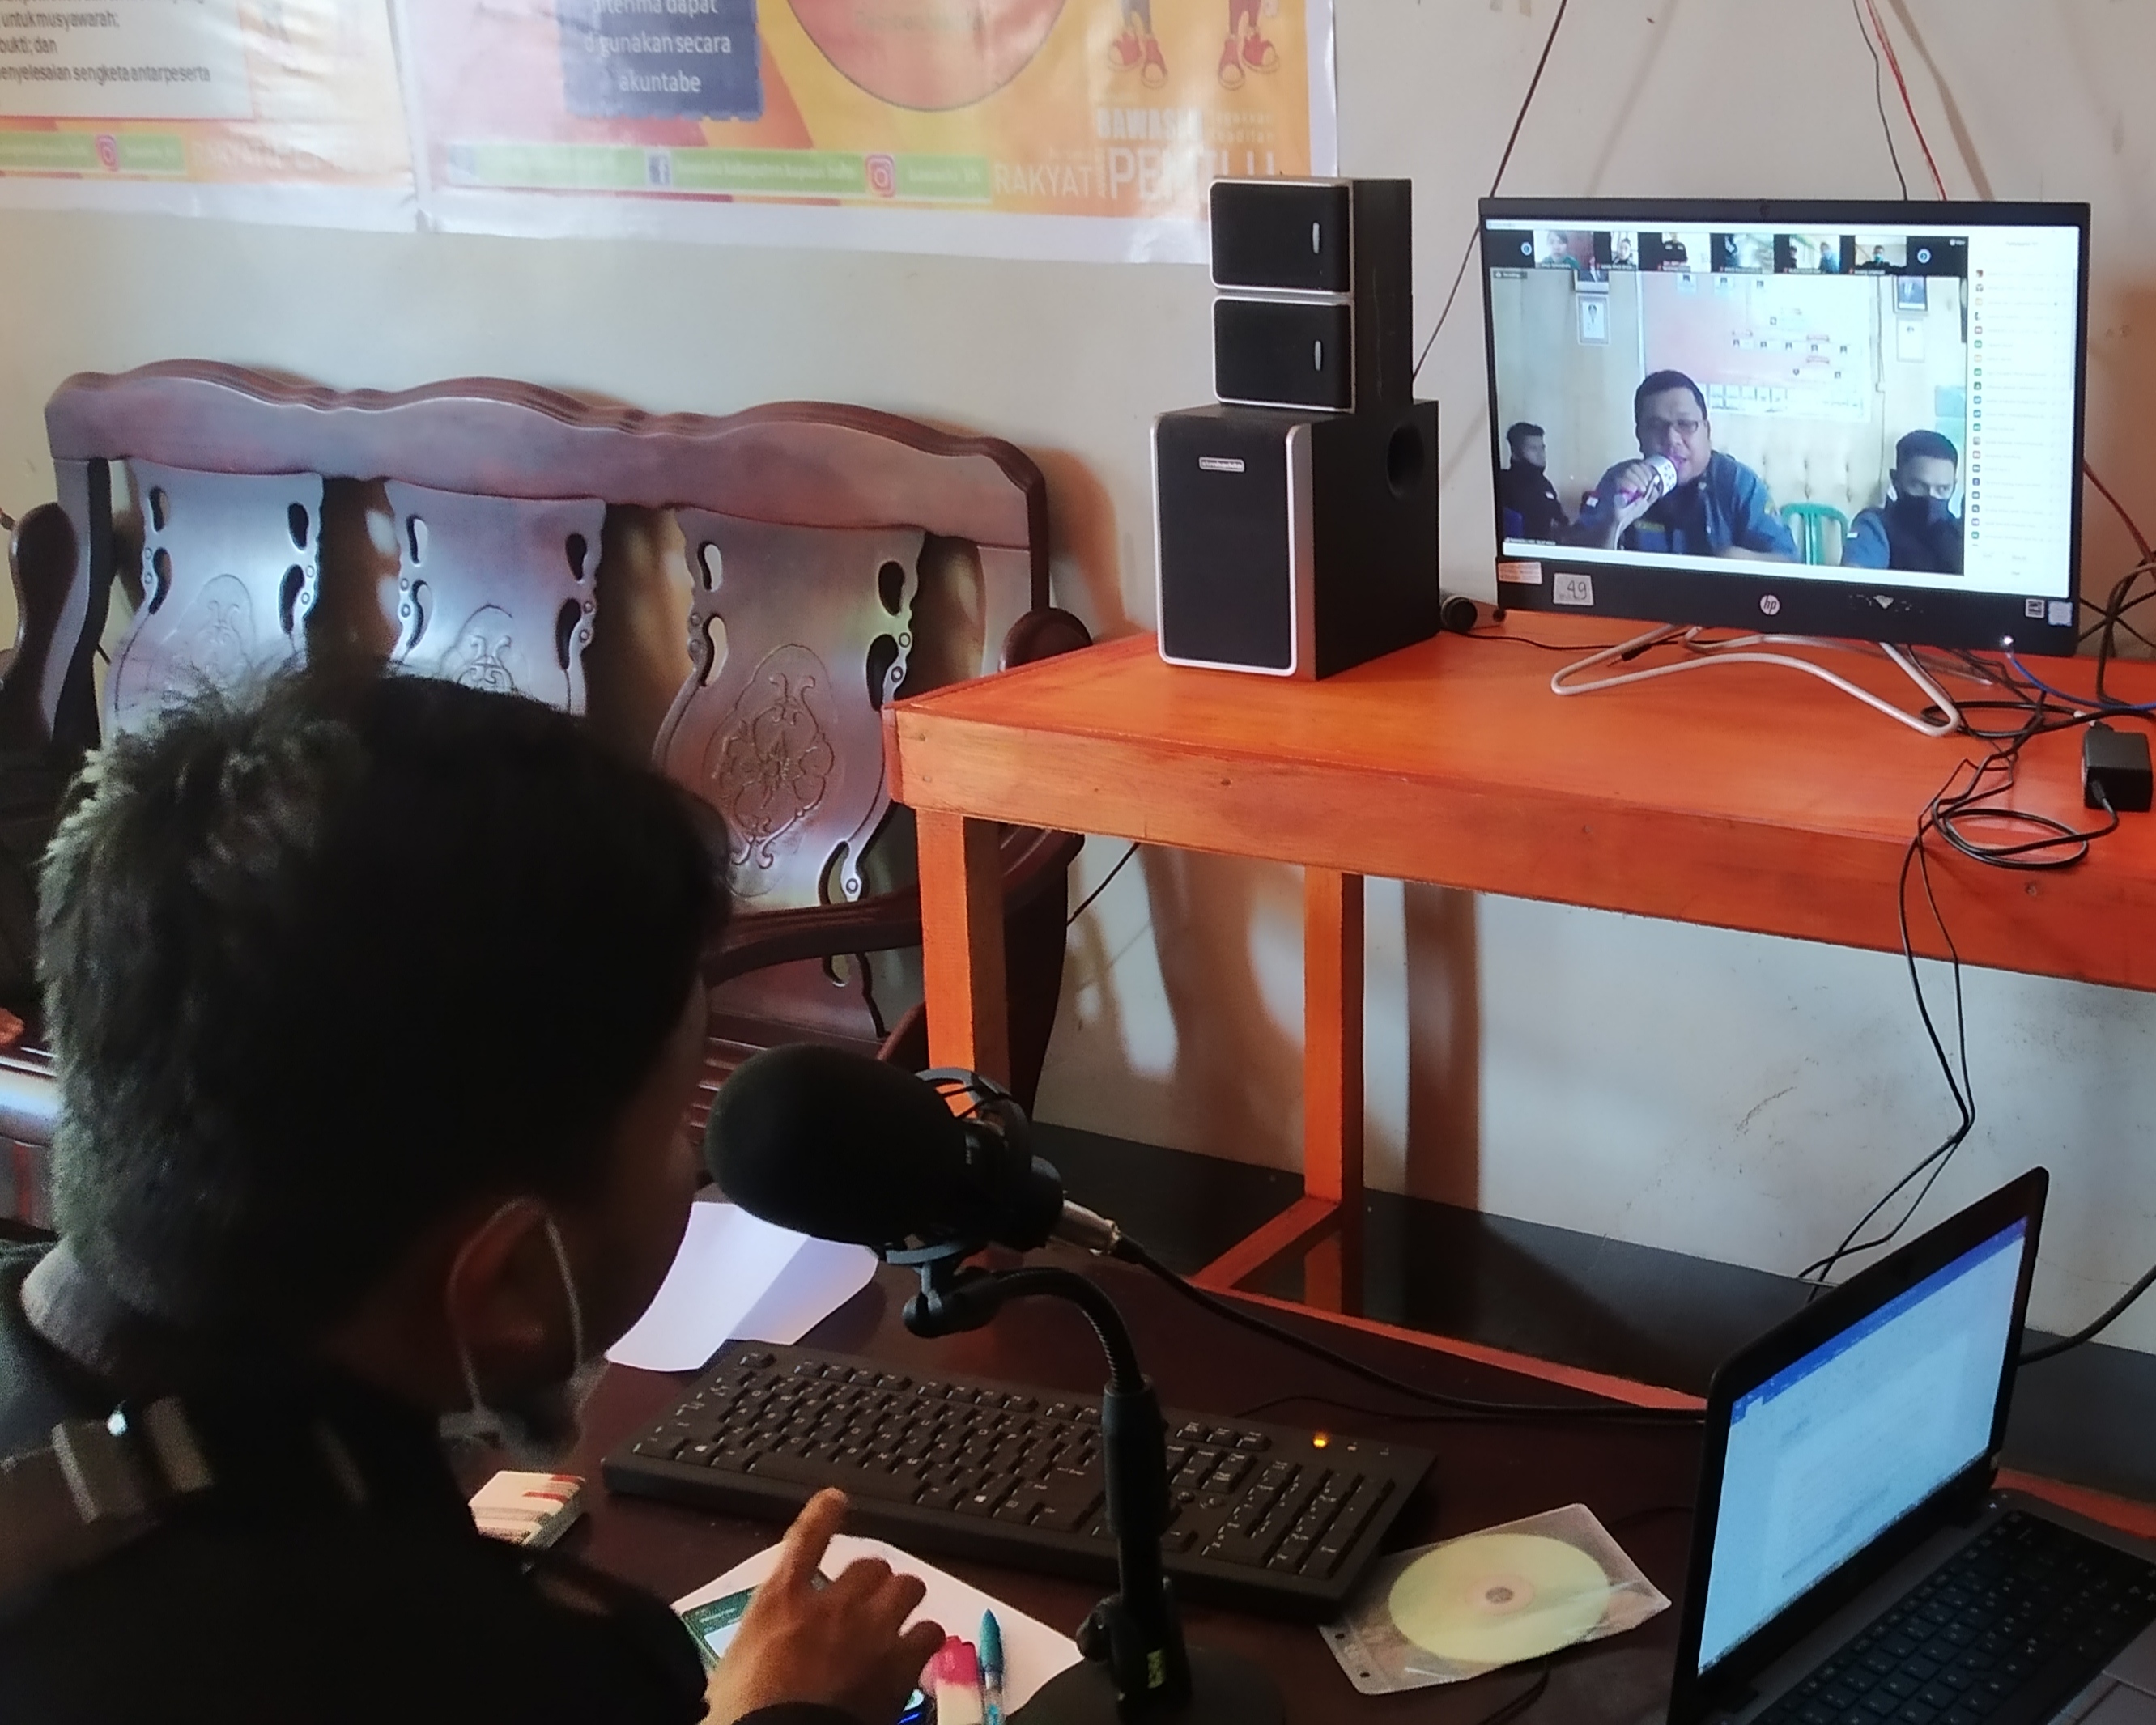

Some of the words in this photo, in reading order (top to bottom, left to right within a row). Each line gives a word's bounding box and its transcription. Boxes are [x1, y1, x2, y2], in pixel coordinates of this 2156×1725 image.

[2, 11, 36, 28] untuk
[34, 37, 57, 54] dan
[585, 30, 673, 57] dgunakan
[677, 36, 731, 53] secara
[993, 162, 1093, 198] RAKYAT
[1567, 580, 1588, 600] 49
[1763, 595, 1777, 614] hp
